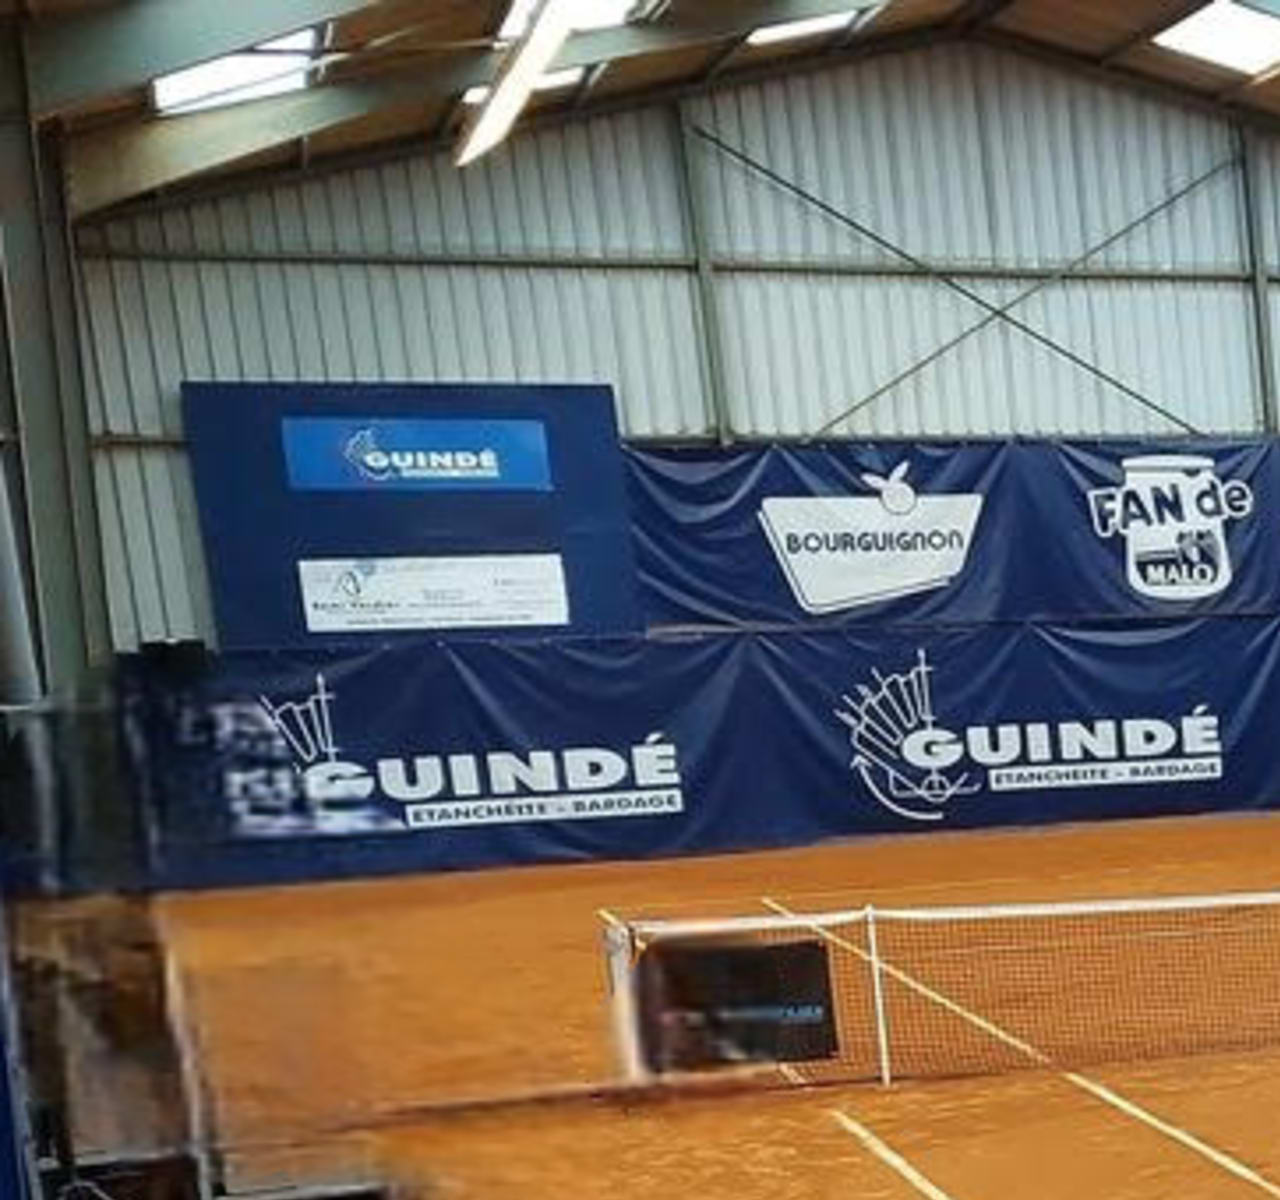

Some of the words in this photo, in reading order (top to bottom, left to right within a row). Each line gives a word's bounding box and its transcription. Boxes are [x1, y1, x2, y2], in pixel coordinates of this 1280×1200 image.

[1094, 483, 1186, 534] FAN
[1196, 479, 1248, 516] de
[1146, 563, 1214, 585] MALO
[902, 705, 1222, 769] GUINDÉ
[303, 732, 682, 803] GUINDÉ
[1128, 760, 1220, 779] BARDAGE
